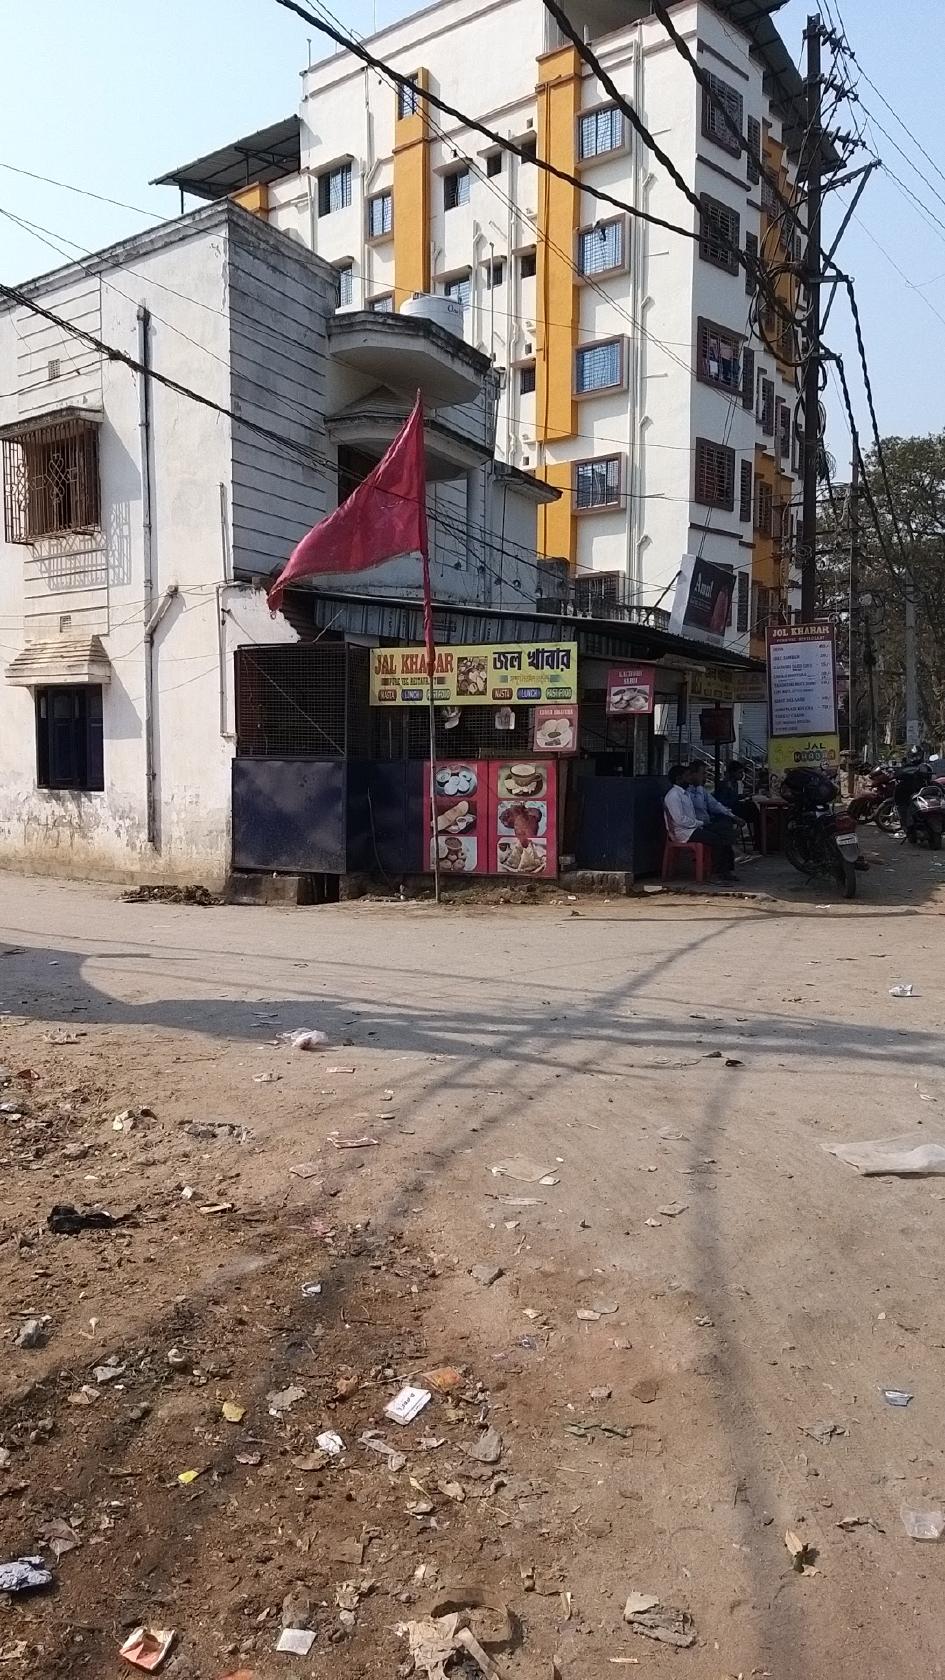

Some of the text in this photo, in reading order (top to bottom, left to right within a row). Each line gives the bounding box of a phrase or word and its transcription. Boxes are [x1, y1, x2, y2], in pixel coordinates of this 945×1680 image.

[773, 626, 830, 637] JOL KHABAR
[375, 653, 454, 675] JAL KHAAR
[493, 648, 571, 672] জল খাবার
[804, 742, 826, 750] JAL
